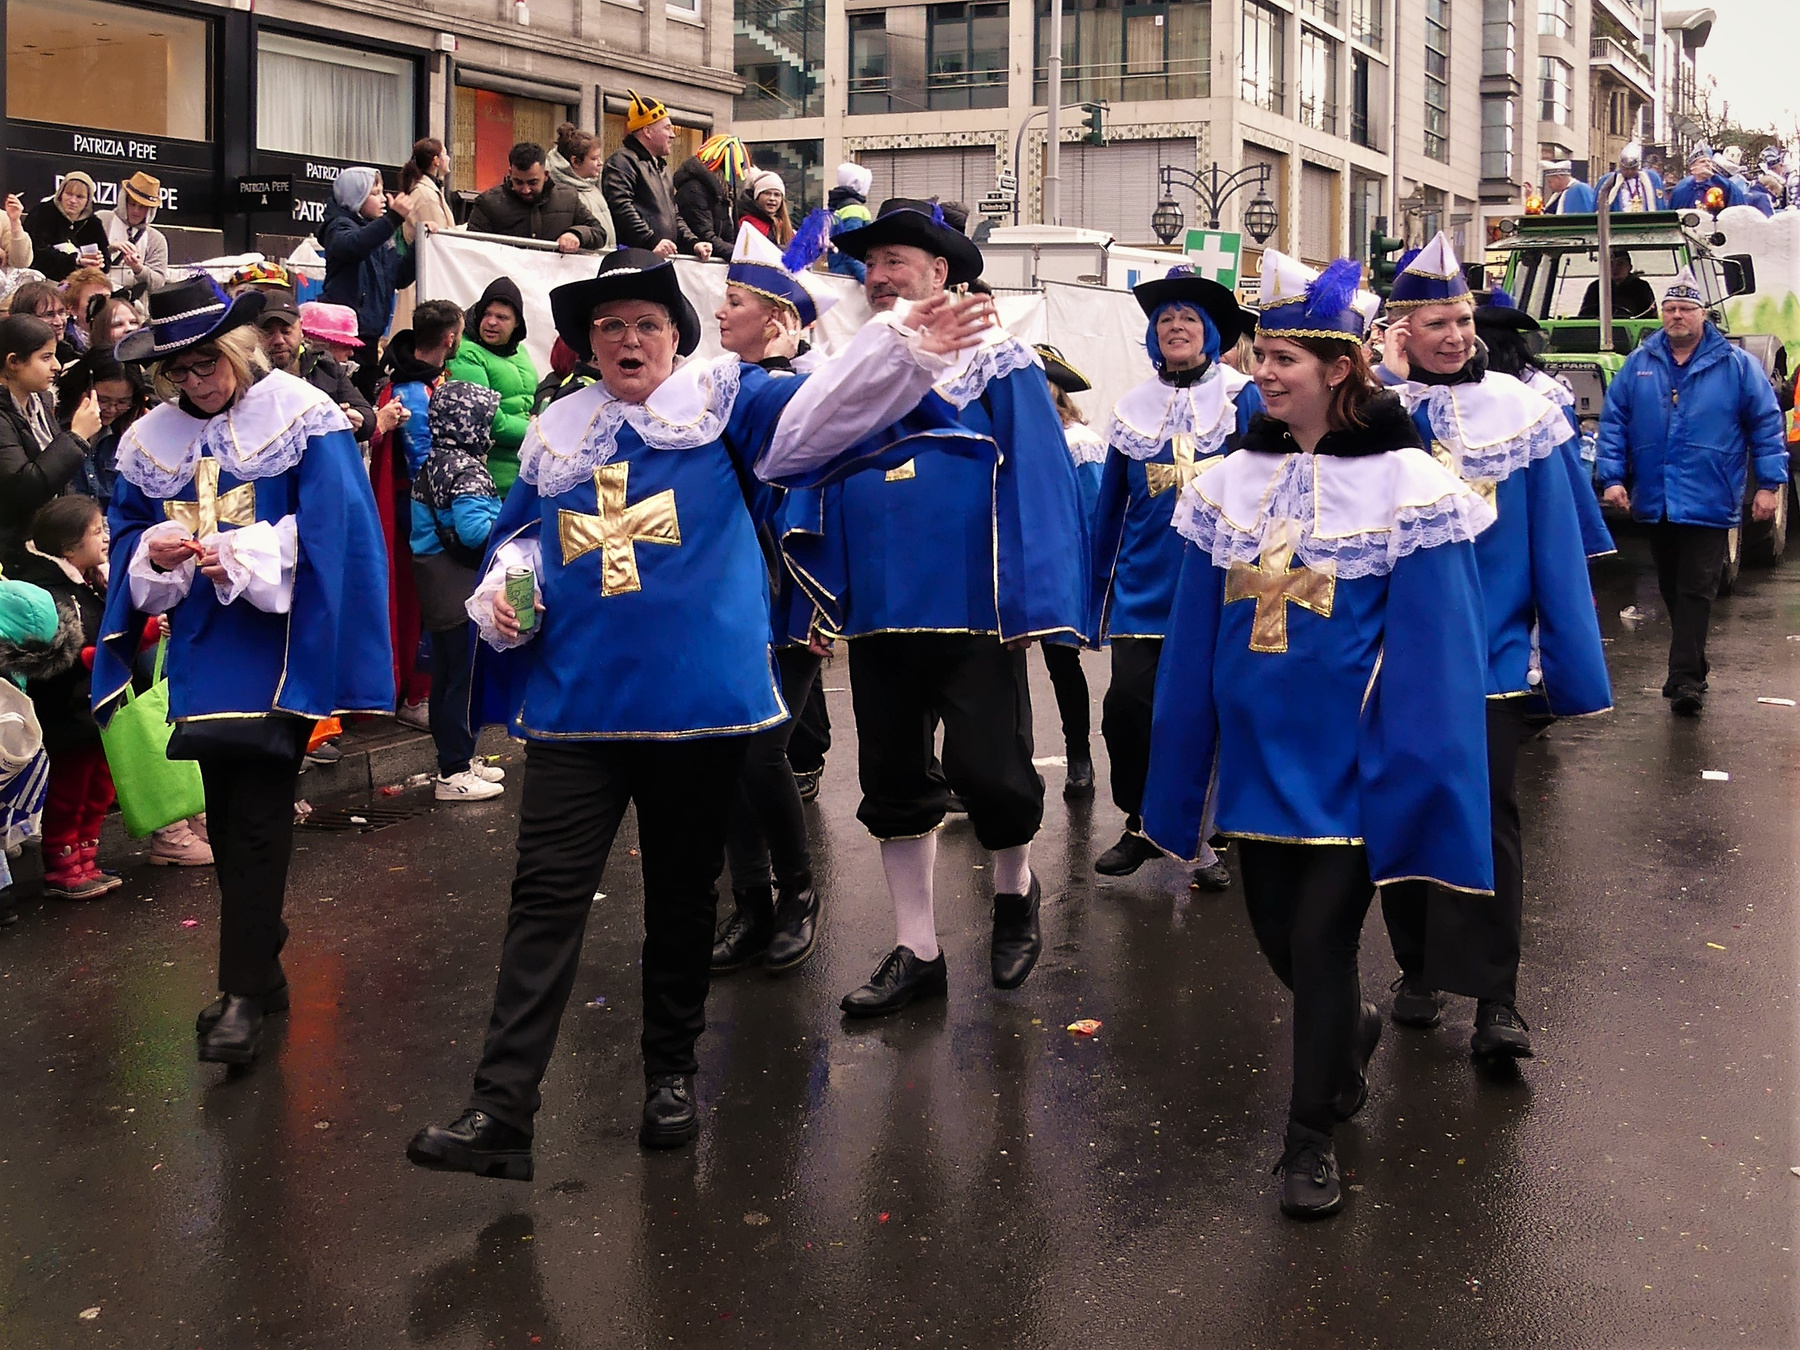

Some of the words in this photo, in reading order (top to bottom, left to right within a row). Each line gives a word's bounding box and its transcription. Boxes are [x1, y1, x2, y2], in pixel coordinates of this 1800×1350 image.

[73, 134, 126, 157] PATRIZIA
[128, 140, 157, 160] PEPE
[306, 162, 345, 180] PATRIZI
[240, 182, 271, 193] PATRIZIA
[271, 181, 290, 192] PEPE
[292, 198, 327, 222] PATR
